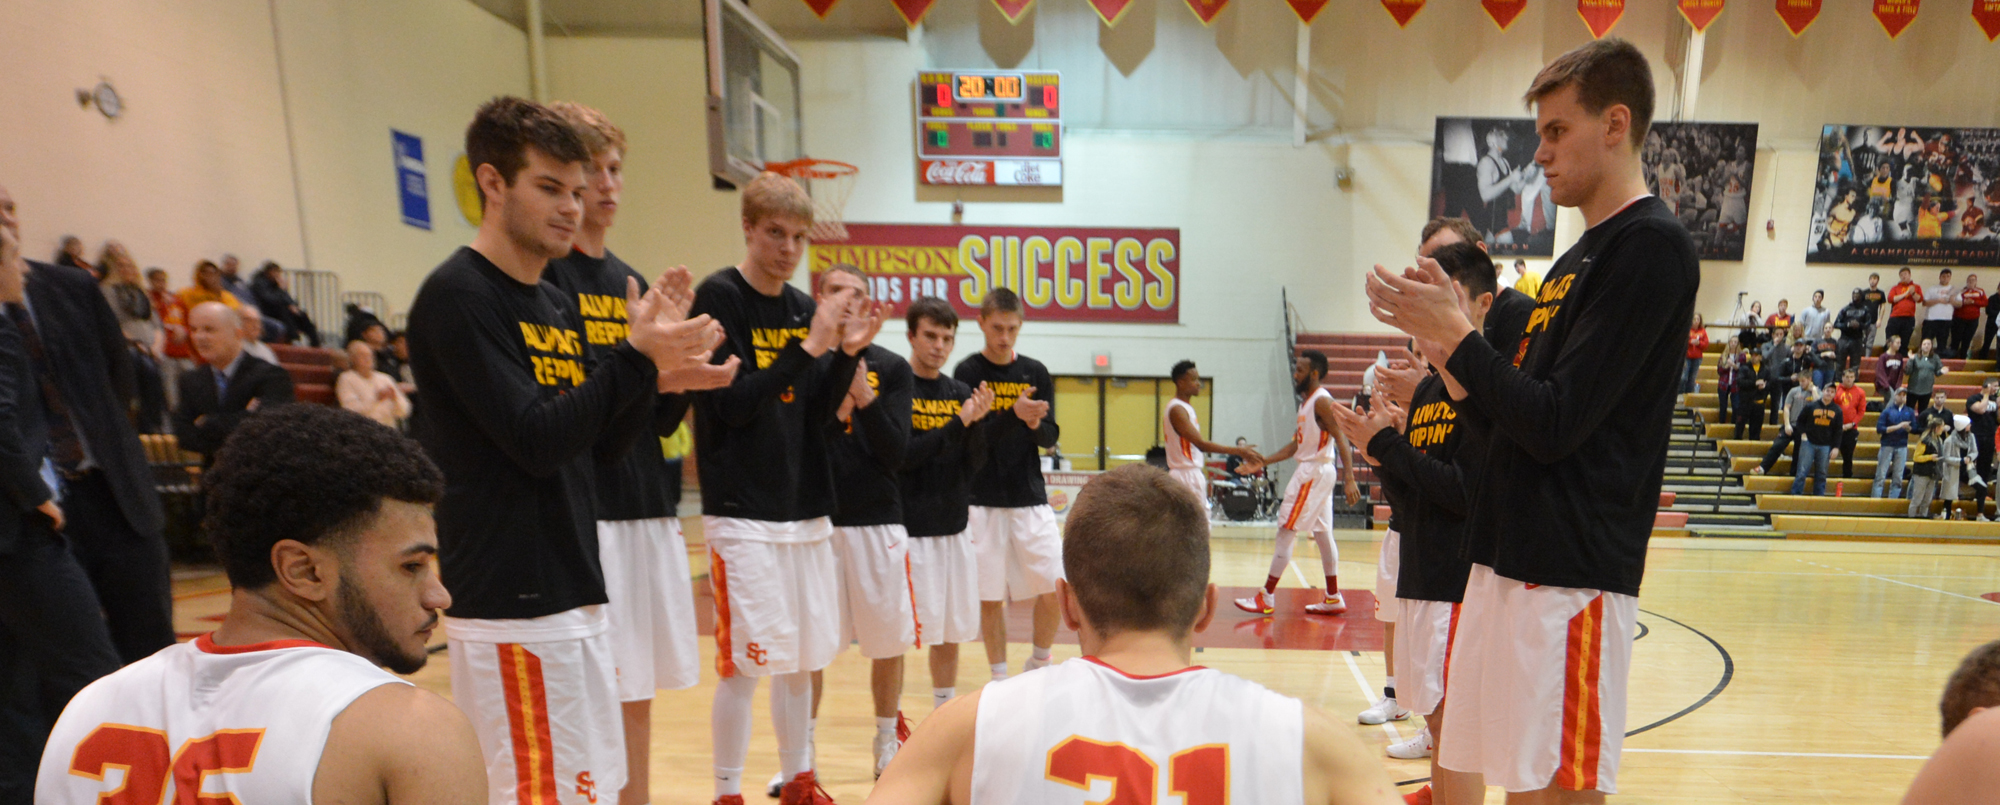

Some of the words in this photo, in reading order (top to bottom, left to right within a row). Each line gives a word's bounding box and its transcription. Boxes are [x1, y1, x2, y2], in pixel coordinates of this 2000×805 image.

[1851, 247, 1858, 255] A
[1862, 248, 1951, 257] CHAMPIONSHIP
[959, 235, 1176, 311] SUCCESS
[910, 277, 949, 301] FOR
[745, 642, 768, 666] SC
